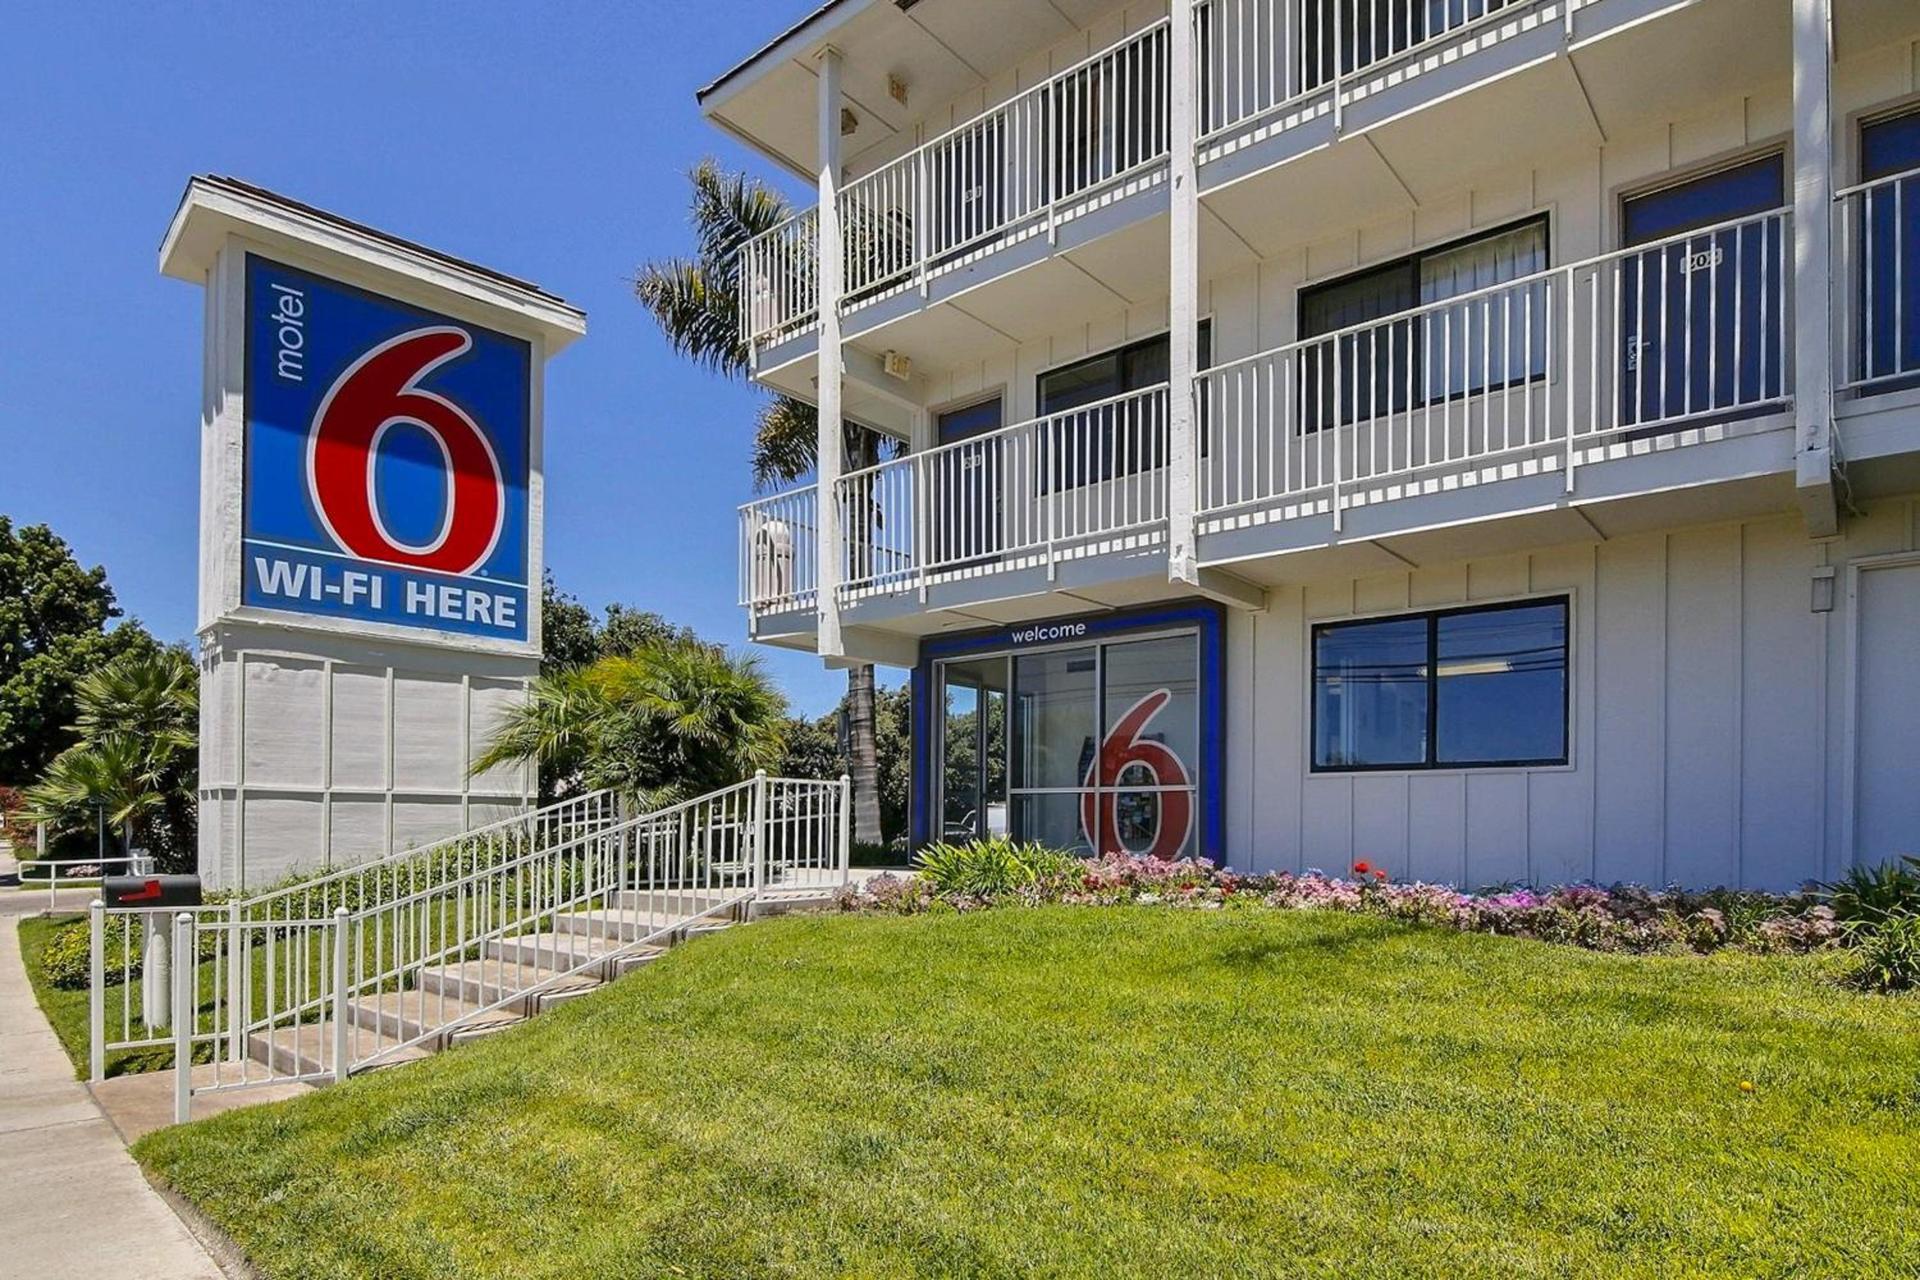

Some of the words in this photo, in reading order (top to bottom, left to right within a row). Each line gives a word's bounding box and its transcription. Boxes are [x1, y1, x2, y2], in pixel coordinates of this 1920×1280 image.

[271, 283, 303, 382] motel
[306, 325, 506, 575] 6
[254, 557, 382, 609] WI-FI
[406, 581, 516, 628] HERE
[1011, 623, 1086, 644] welcome
[1080, 687, 1194, 860] 6
